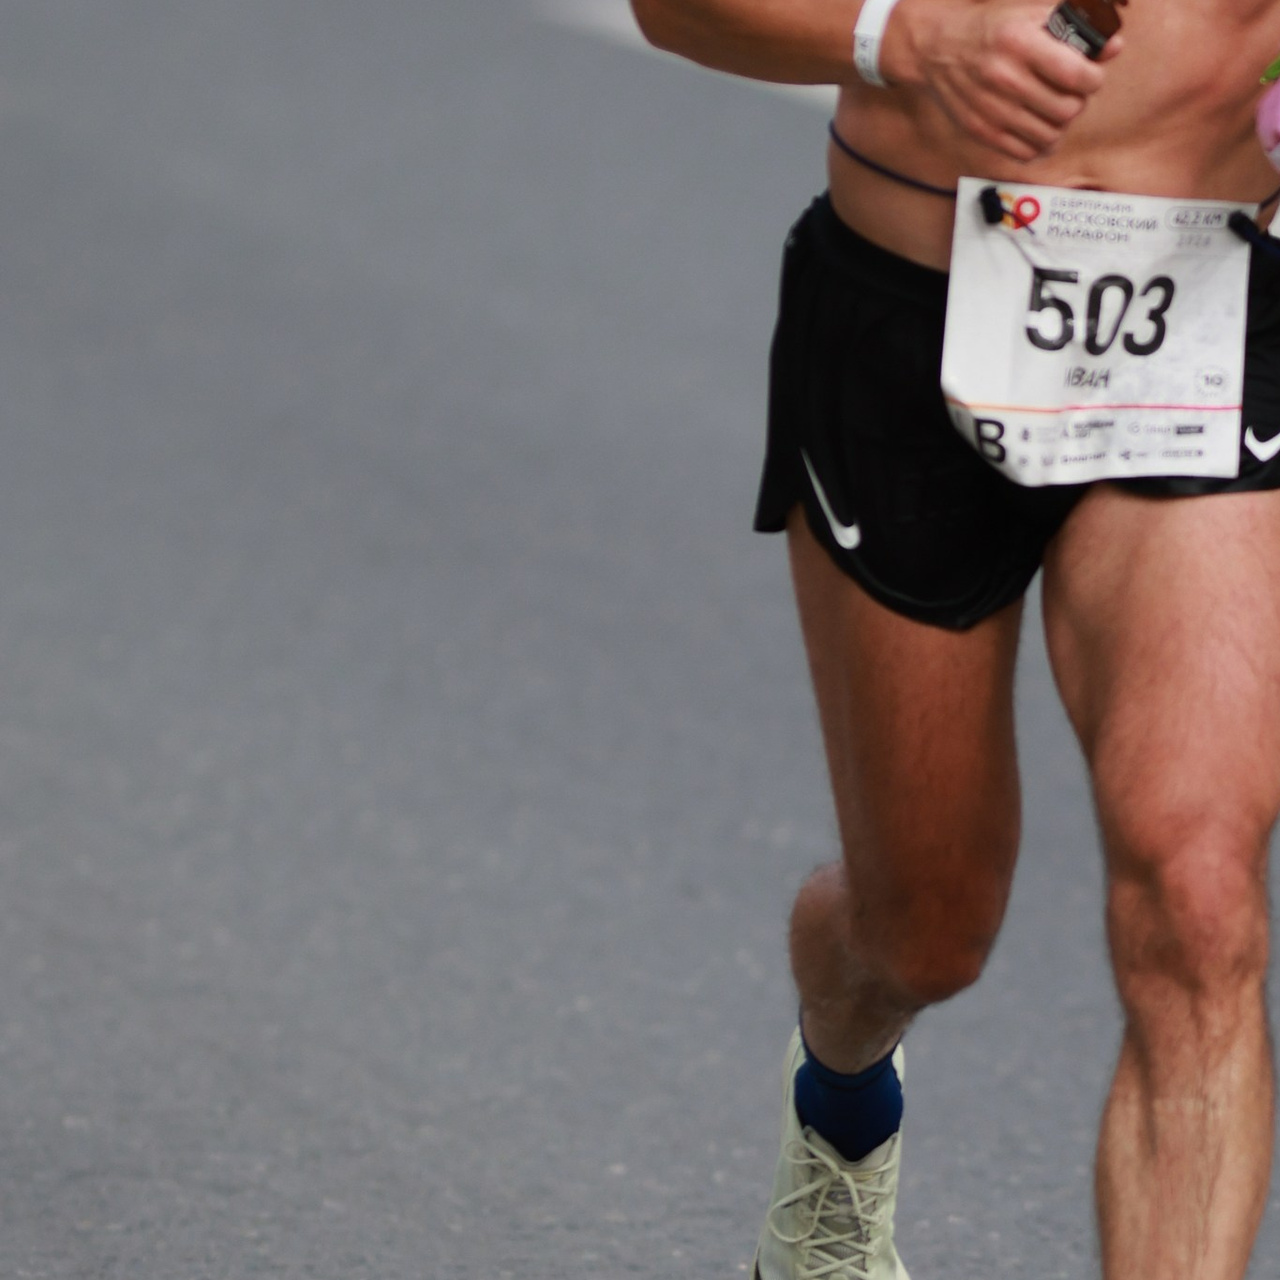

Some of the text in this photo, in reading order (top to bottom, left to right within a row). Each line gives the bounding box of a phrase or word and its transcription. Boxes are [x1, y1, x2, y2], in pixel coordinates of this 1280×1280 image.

[1049, 210, 1159, 231] МОСКОВСКИЙ
[1047, 225, 1131, 243] МАРАФОН
[1025, 266, 1175, 356] 503
